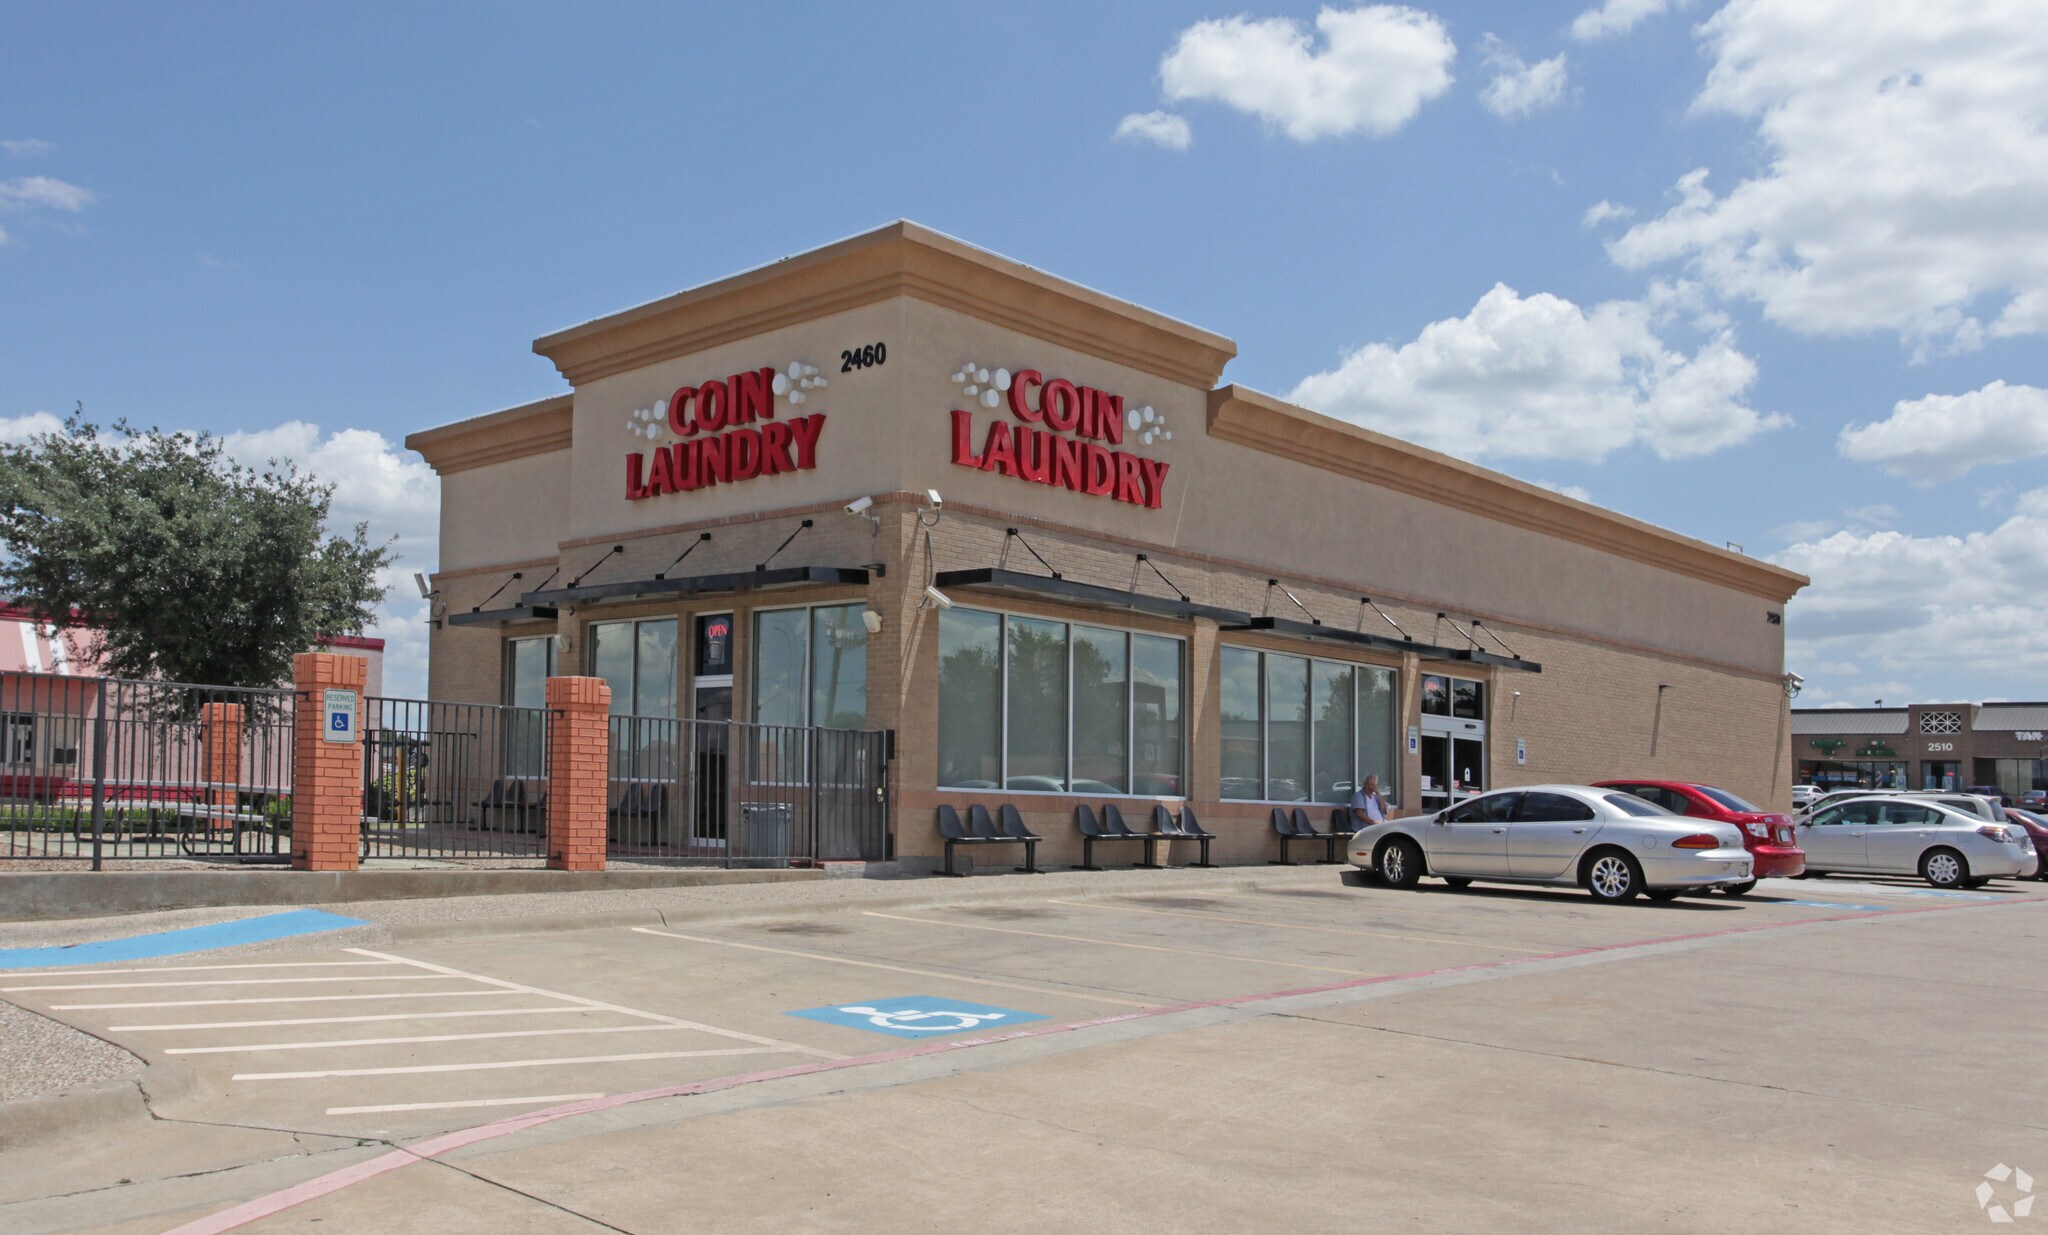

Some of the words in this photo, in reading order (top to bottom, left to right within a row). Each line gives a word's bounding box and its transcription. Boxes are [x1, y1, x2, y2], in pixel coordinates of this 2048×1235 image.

[841, 342, 887, 373] 2460
[668, 367, 775, 437] COIN
[1008, 369, 1124, 444] COIN
[625, 413, 827, 501] LAUNDRY
[950, 410, 1171, 509] LAUNDRY
[708, 624, 728, 637] OPEN
[326, 694, 355, 702] RESERVED
[328, 703, 353, 711] PARKING
[1928, 743, 1953, 751] 2510
